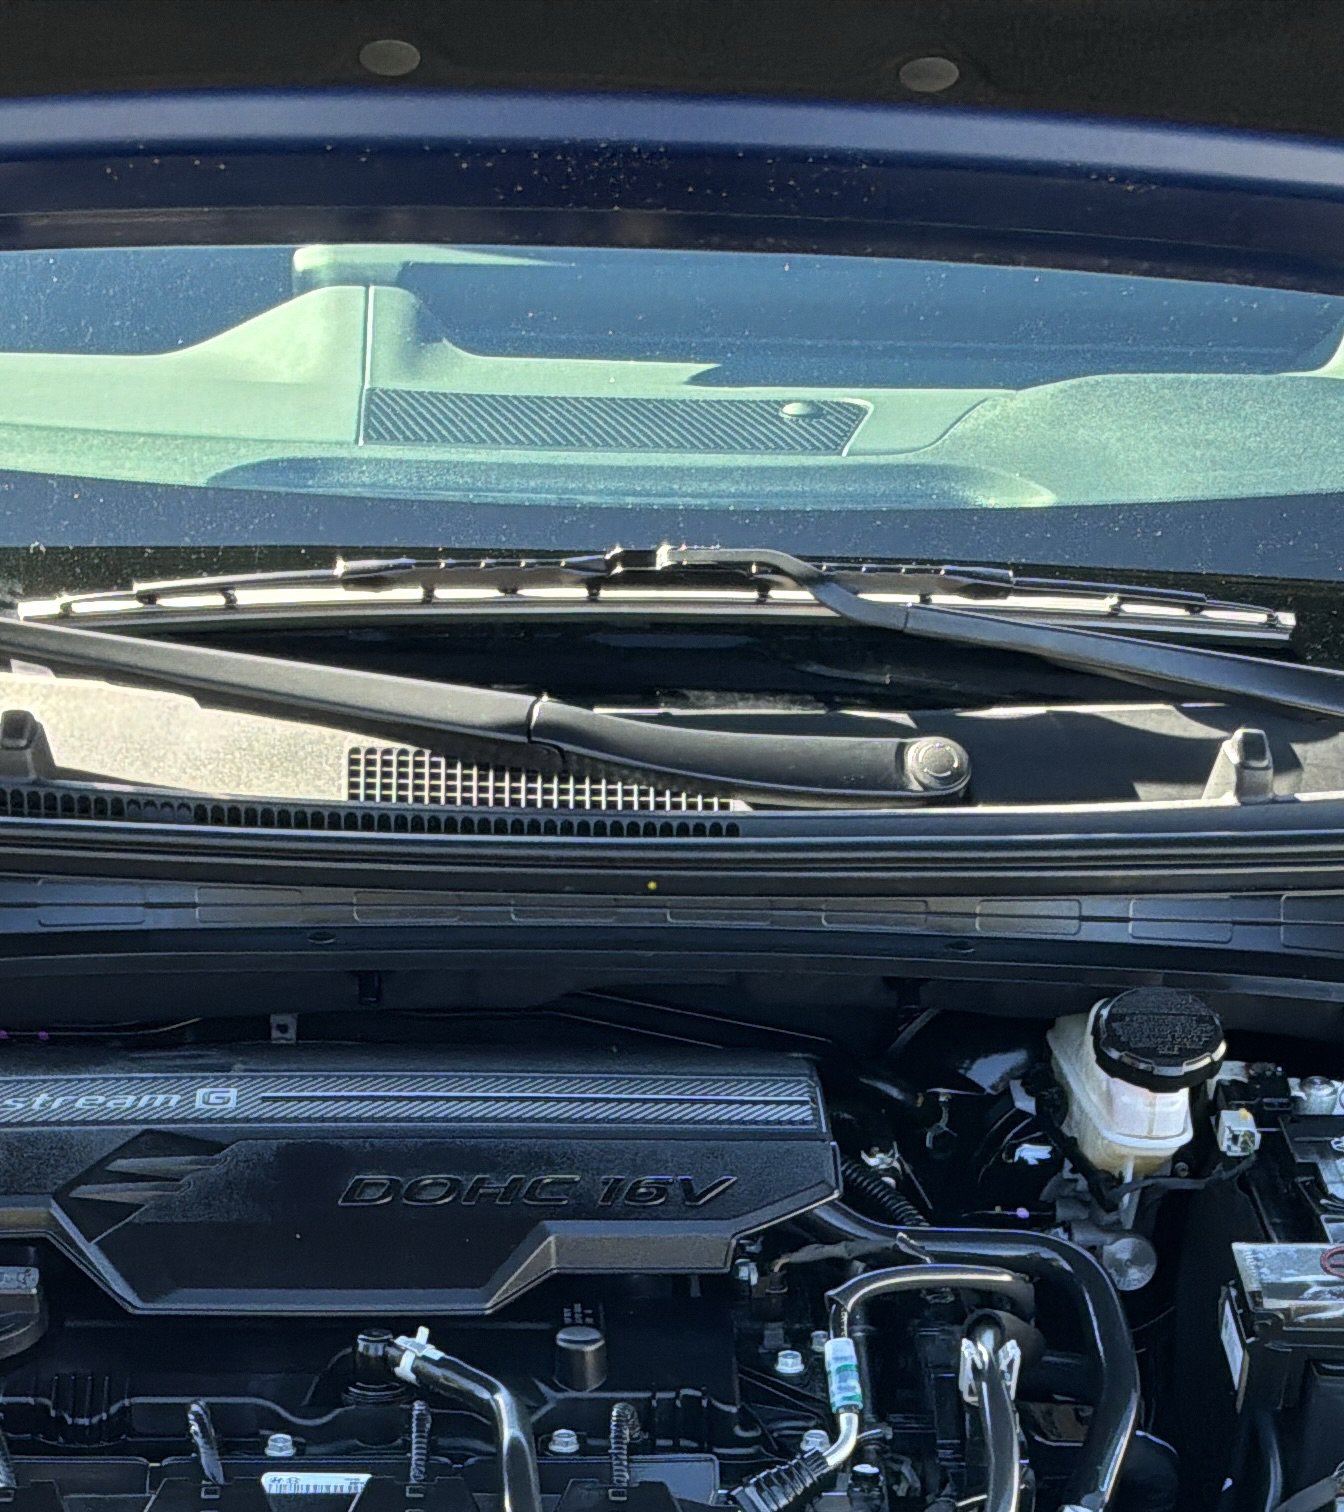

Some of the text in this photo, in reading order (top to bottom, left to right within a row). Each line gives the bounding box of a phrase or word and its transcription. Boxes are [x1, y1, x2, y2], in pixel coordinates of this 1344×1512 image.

[196, 1088, 237, 1109] G
[338, 1174, 738, 1206] DOHC 16V
